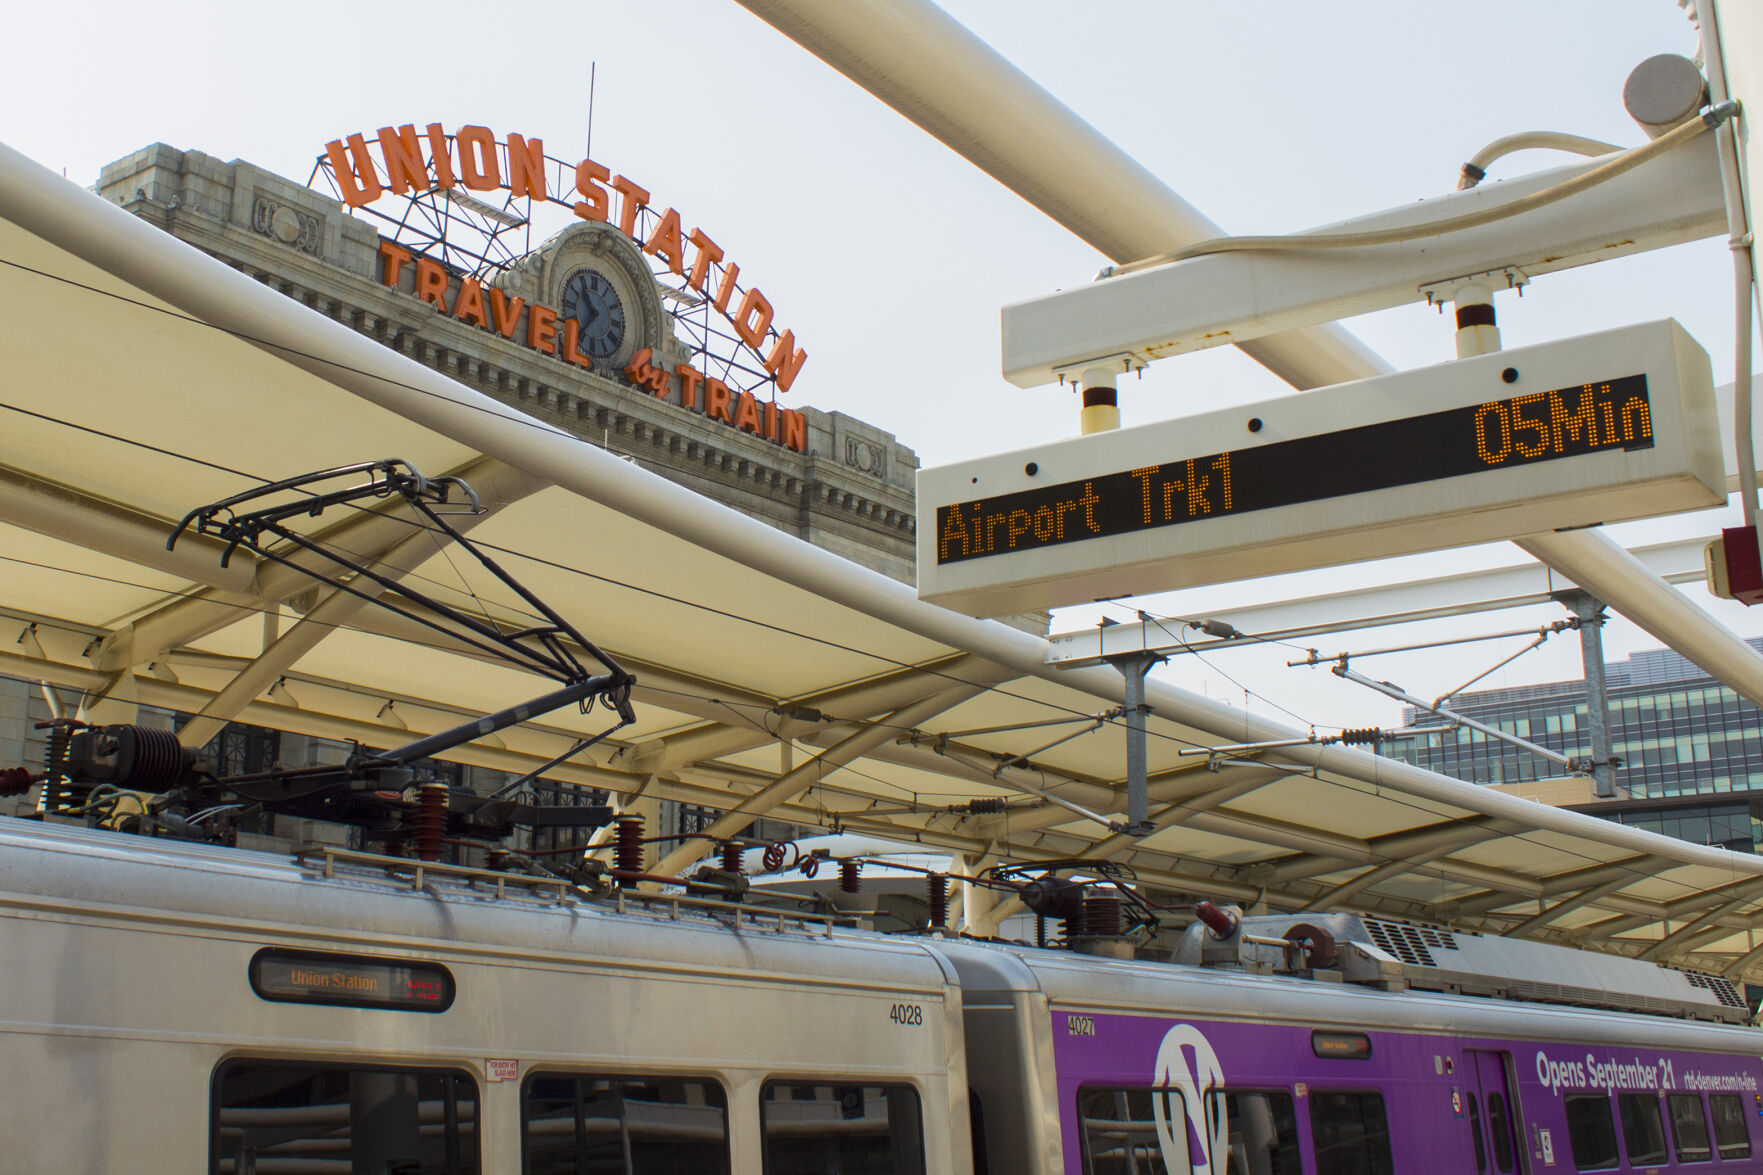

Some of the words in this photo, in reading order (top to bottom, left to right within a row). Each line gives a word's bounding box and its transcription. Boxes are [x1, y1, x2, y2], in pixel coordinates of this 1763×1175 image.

[325, 122, 548, 208] UNION
[574, 158, 808, 393] STATION
[378, 241, 591, 369] TRAVEL
[624, 347, 671, 400] by
[674, 363, 806, 452] TRAIN
[941, 482, 1100, 559] Airport
[1131, 451, 1232, 524] Trk1
[291, 969, 329, 988] Union
[332, 972, 378, 991] Station
[889, 1004, 923, 1026] 4028
[1068, 1016, 1095, 1036] 4027
[1536, 1050, 1586, 1096] Opens
[1586, 1053, 1658, 1096] September
[1658, 1057, 1676, 1089] 21
